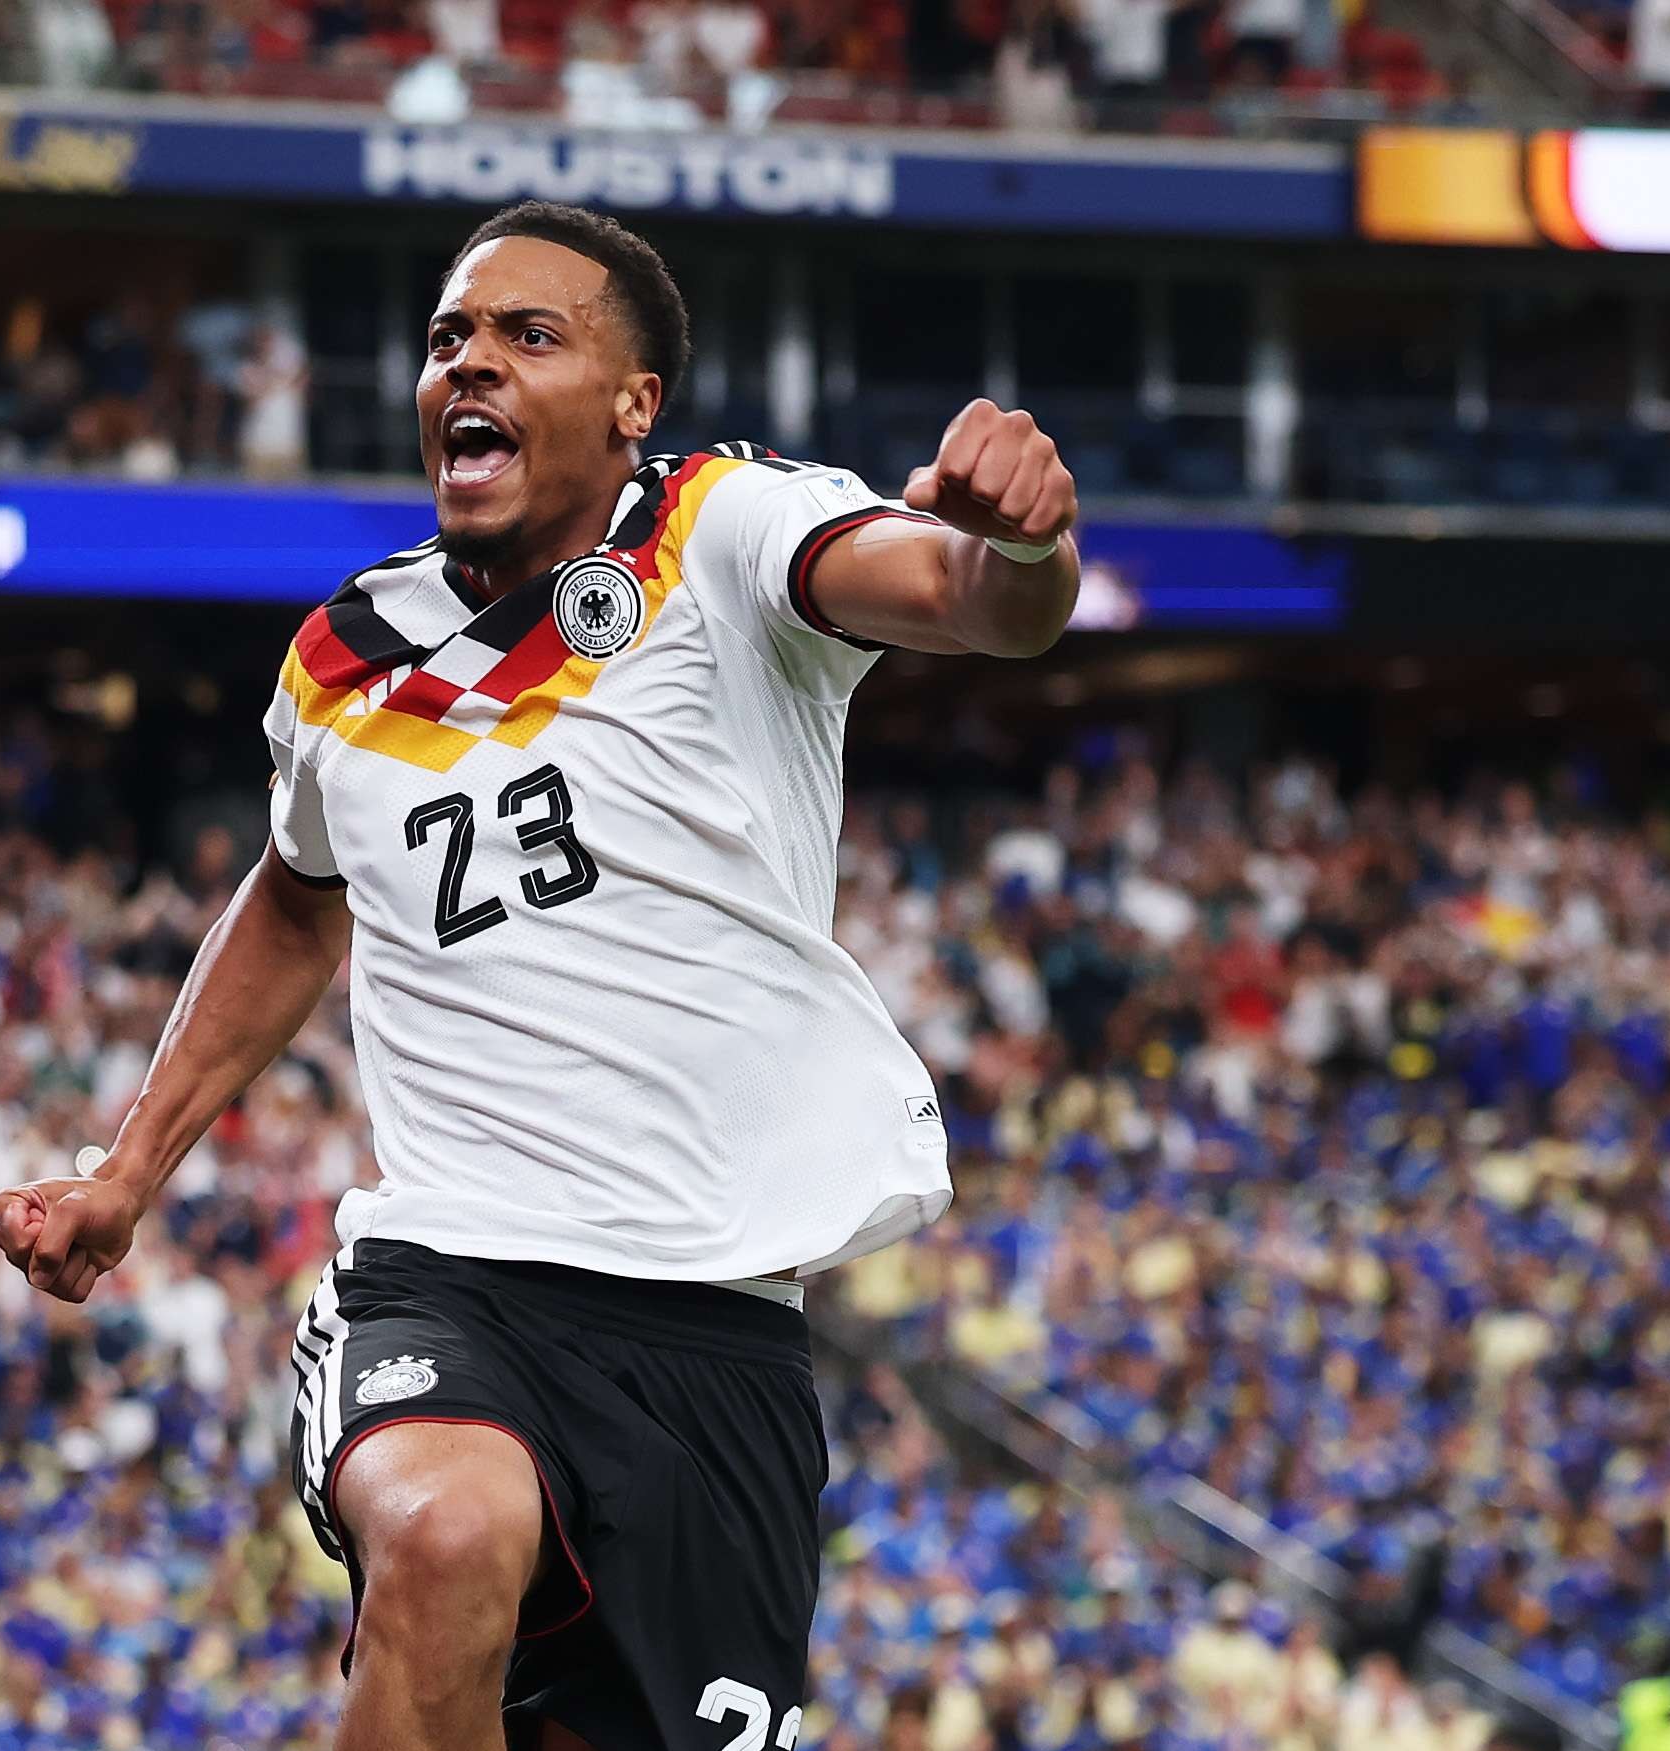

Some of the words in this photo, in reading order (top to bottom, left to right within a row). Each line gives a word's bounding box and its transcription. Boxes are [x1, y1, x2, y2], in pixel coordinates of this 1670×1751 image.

[362, 131, 892, 217] HOUSTON
[570, 574, 619, 596] DEUTSCHER
[570, 616, 628, 646] FUSSBALL-BUND
[404, 763, 600, 949] 23
